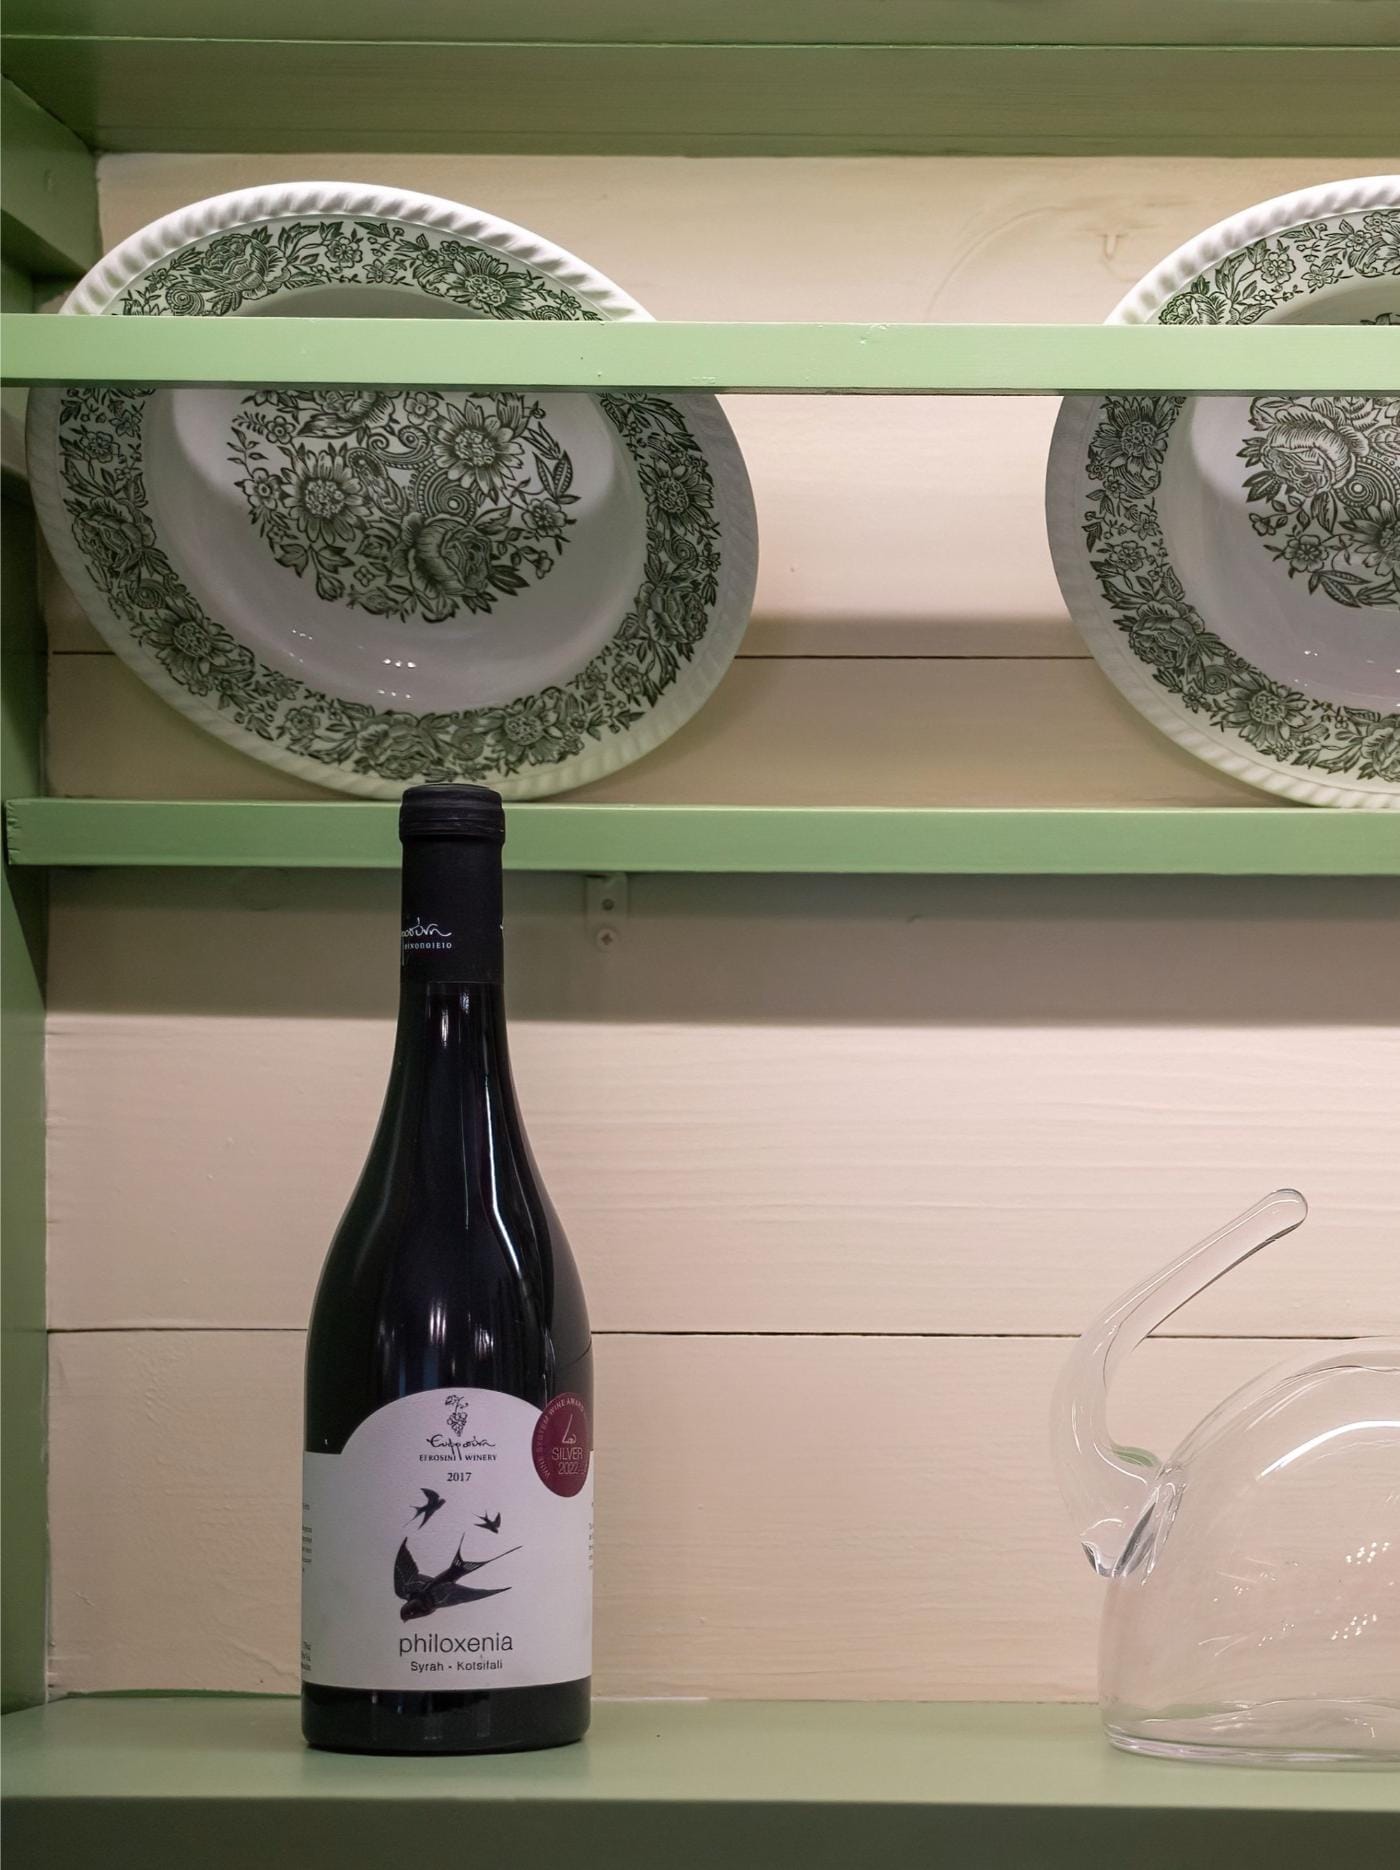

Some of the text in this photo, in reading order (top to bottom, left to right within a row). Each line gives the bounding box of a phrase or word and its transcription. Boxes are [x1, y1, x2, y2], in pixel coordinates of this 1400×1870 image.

[551, 1447, 583, 1460] SILVER
[446, 1472, 472, 1482] 2017
[399, 1632, 513, 1657] philoxenia
[410, 1661, 444, 1673] Syrah
[457, 1660, 503, 1671] Kotsifali
